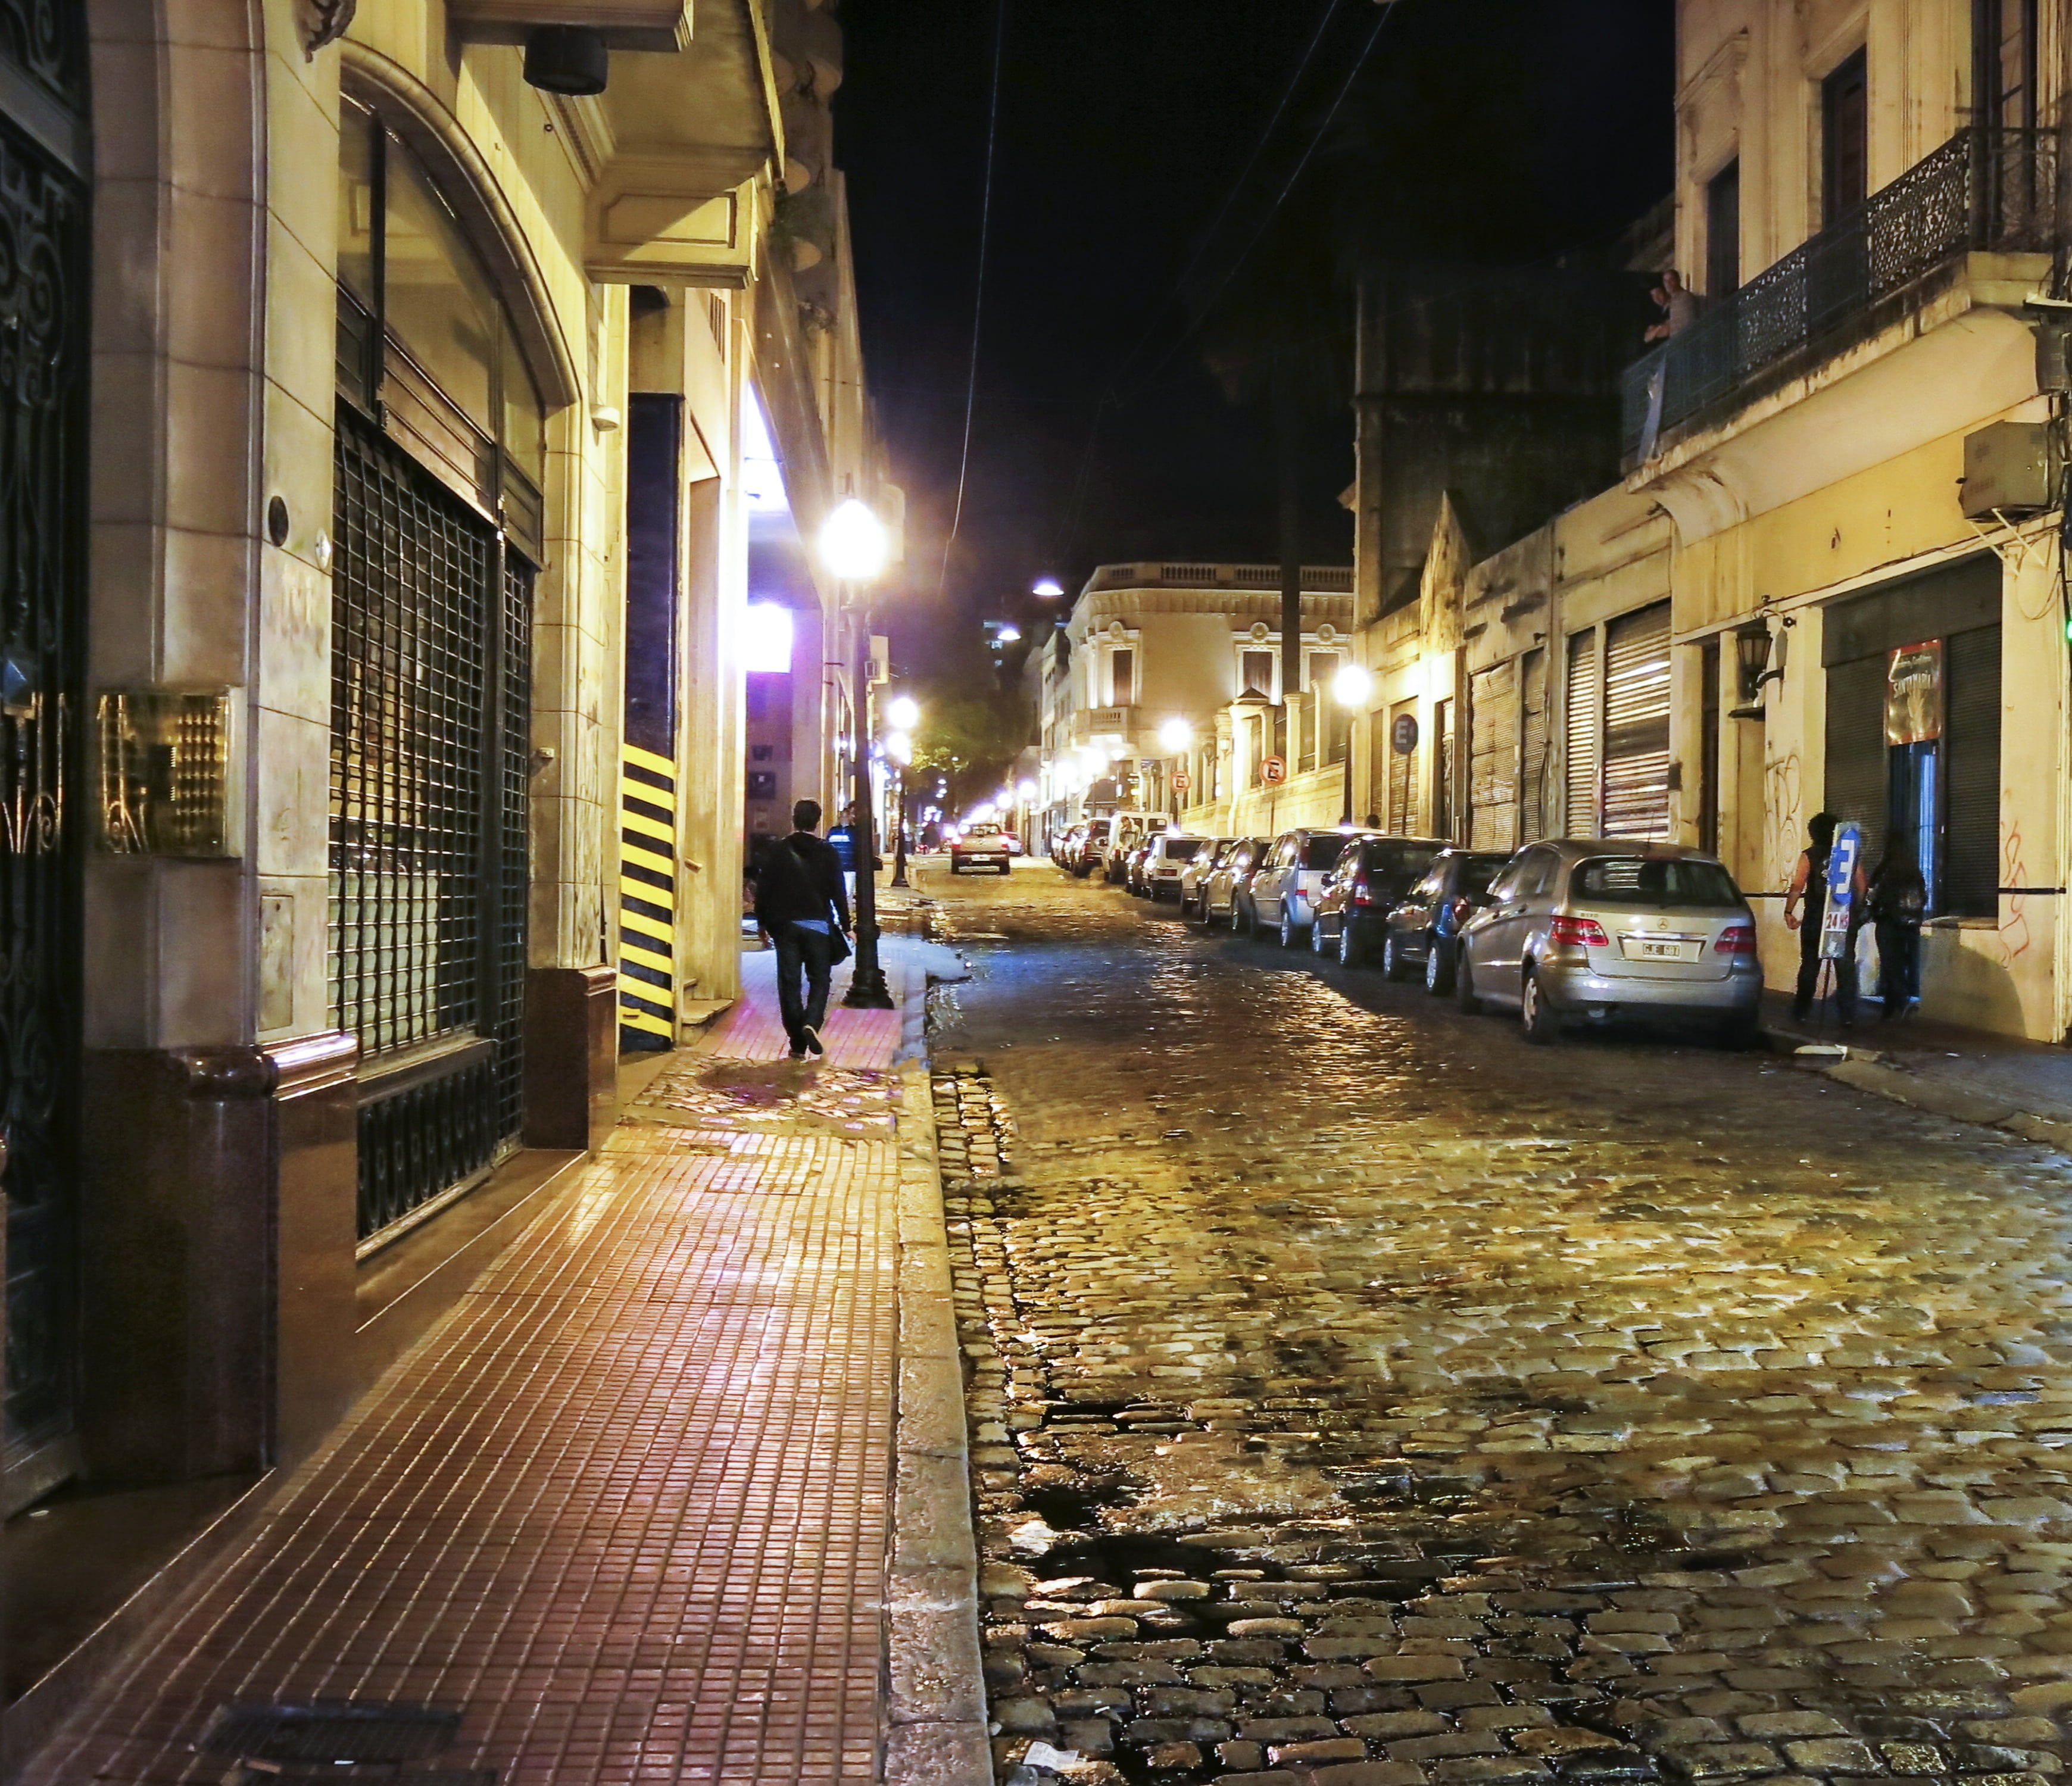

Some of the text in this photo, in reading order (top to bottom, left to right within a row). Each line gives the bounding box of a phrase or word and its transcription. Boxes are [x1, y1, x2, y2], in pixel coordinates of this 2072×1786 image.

[1395, 721, 1408, 744] E
[1826, 913, 1837, 929] 24
[1644, 945, 1659, 955] GJE
